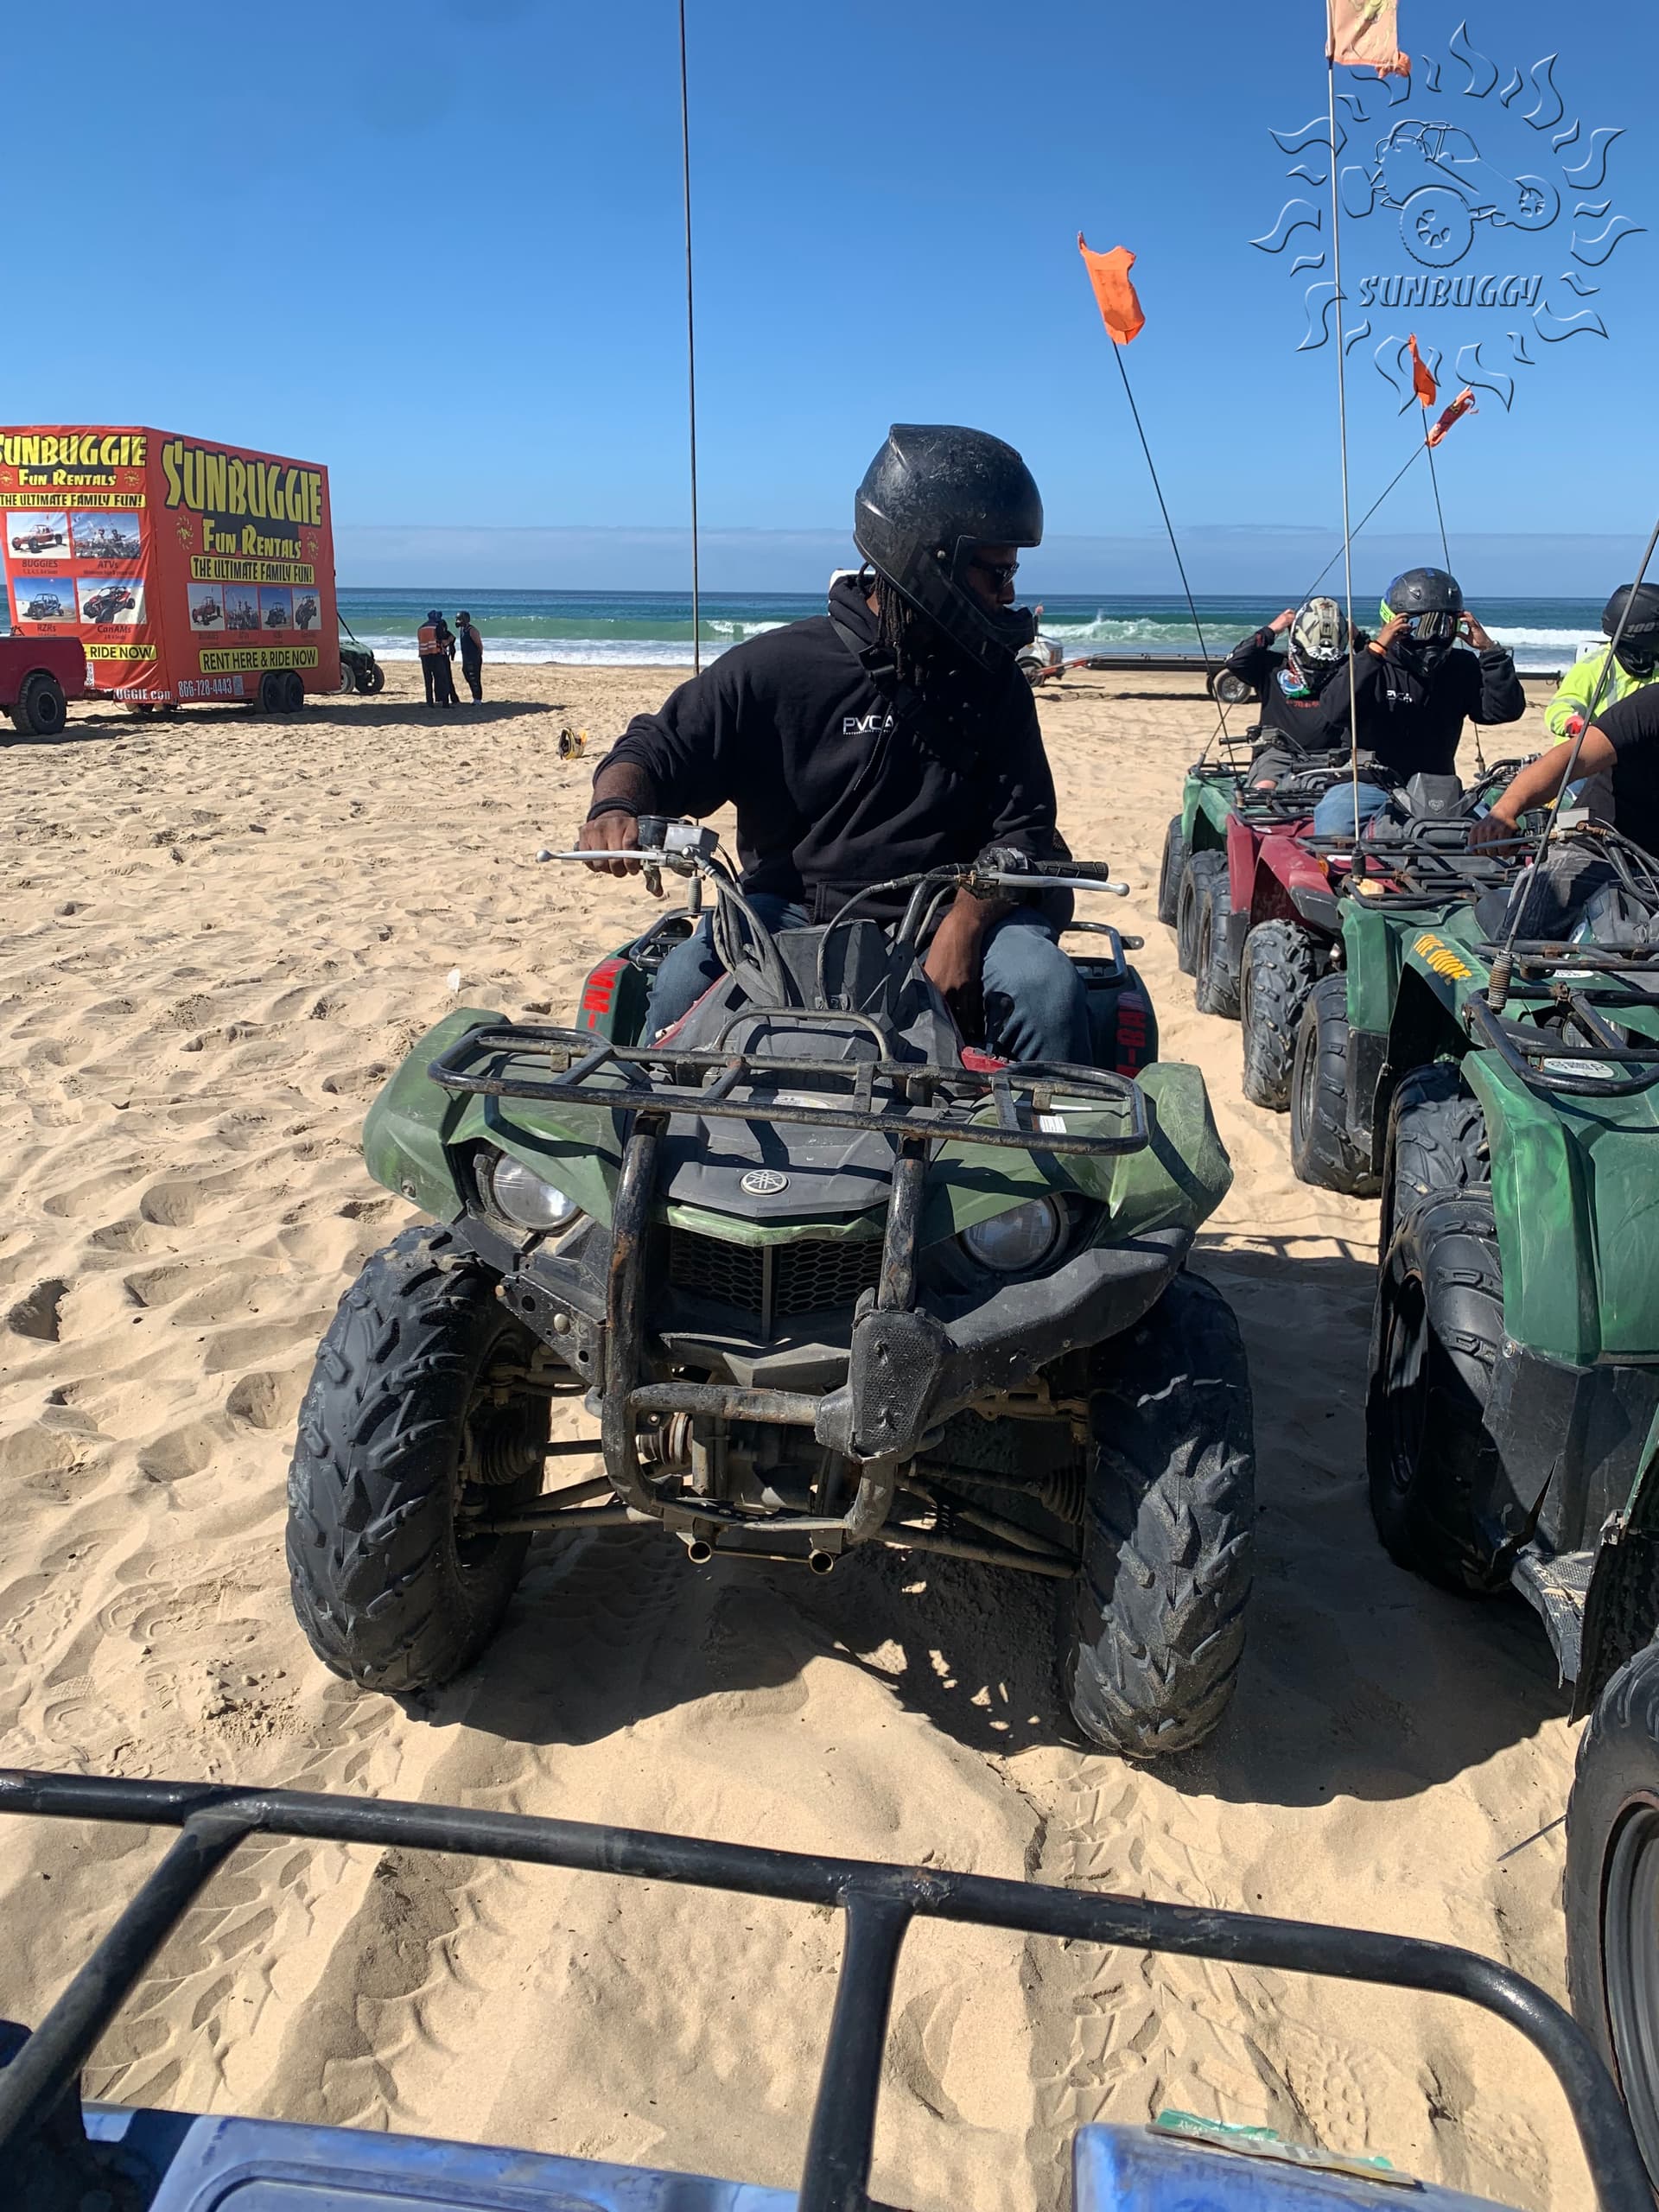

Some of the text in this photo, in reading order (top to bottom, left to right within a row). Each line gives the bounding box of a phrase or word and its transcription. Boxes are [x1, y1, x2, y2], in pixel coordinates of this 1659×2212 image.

[162, 440, 321, 526] SUNBUGGIE
[0, 494, 143, 506] THE ULTIMATE FAMILY FUN!
[22, 559, 58, 568] BUGGIES
[98, 560, 118, 569] ATVs
[193, 556, 312, 583] THE ULTIMATE FAMILY FUN!
[90, 646, 152, 658] RIDE NOW
[203, 649, 316, 671] RENT HERE & RIDE NOW
[178, 677, 232, 698] 866-728-4443
